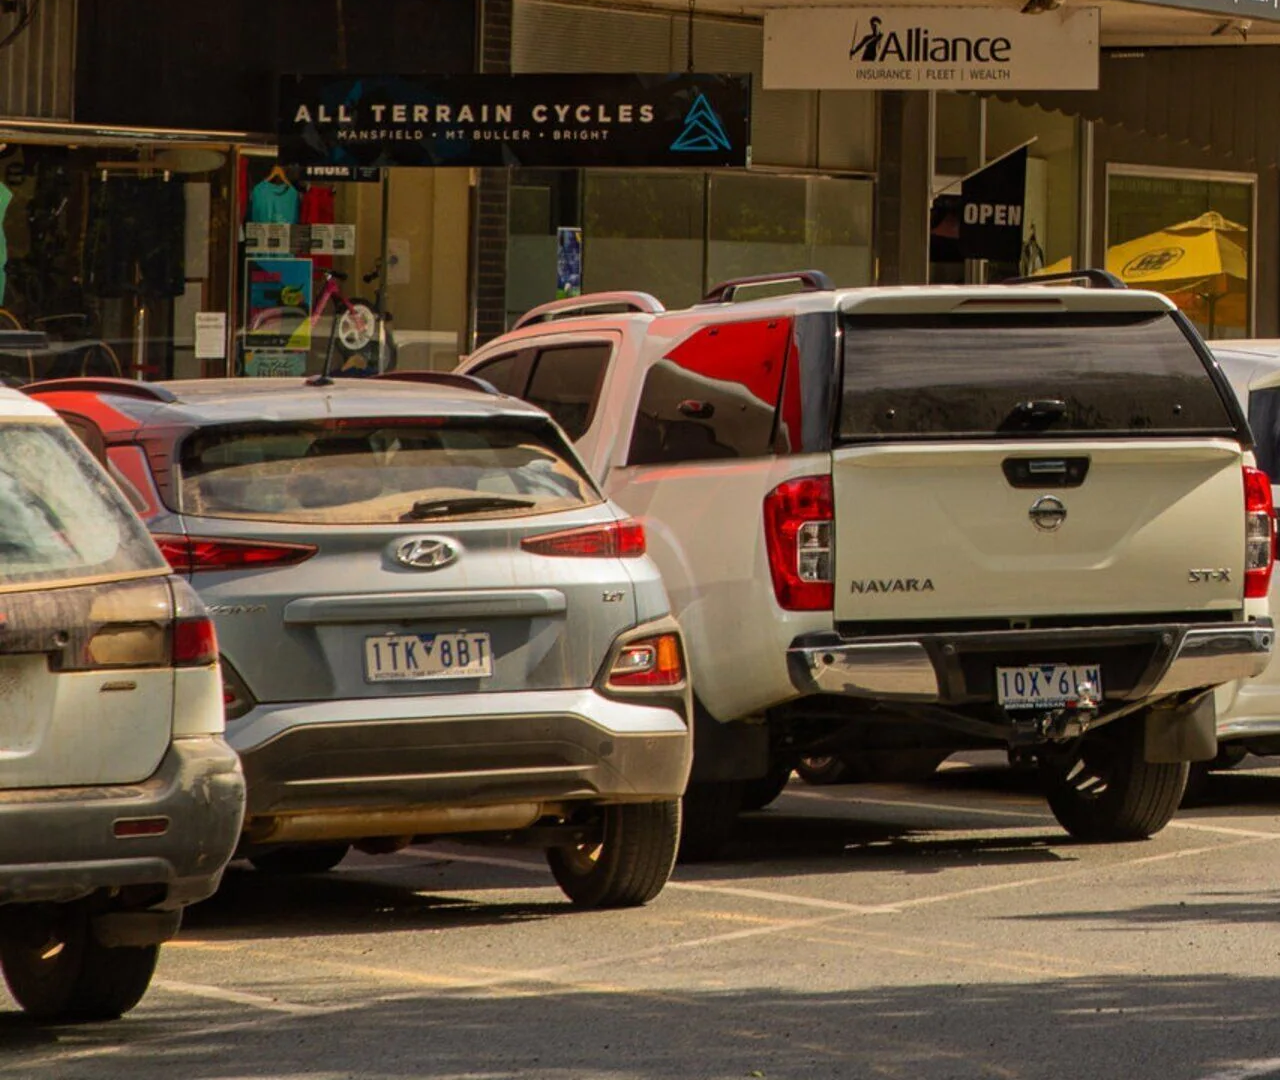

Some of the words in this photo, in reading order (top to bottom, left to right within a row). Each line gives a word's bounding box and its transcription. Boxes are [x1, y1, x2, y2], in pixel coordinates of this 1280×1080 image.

[879, 26, 1011, 63] Alliance
[855, 68, 911, 81] INSURANCE
[926, 68, 955, 81] FLEET
[969, 68, 1010, 81] WEALTH
[294, 104, 352, 123] ALL
[371, 104, 513, 123] TERRAIN
[531, 104, 655, 123] CYCLES
[337, 129, 424, 141] MANSFIELD
[445, 129, 464, 141] MT
[472, 129, 531, 141] BULLER
[552, 129, 609, 141] BRIGHT
[963, 203, 1022, 226] OPEN
[850, 578, 935, 595] NAVARA
[1188, 568, 1232, 584] ST-X
[372, 642, 419, 671] 1TK
[440, 638, 486, 668] 8BT
